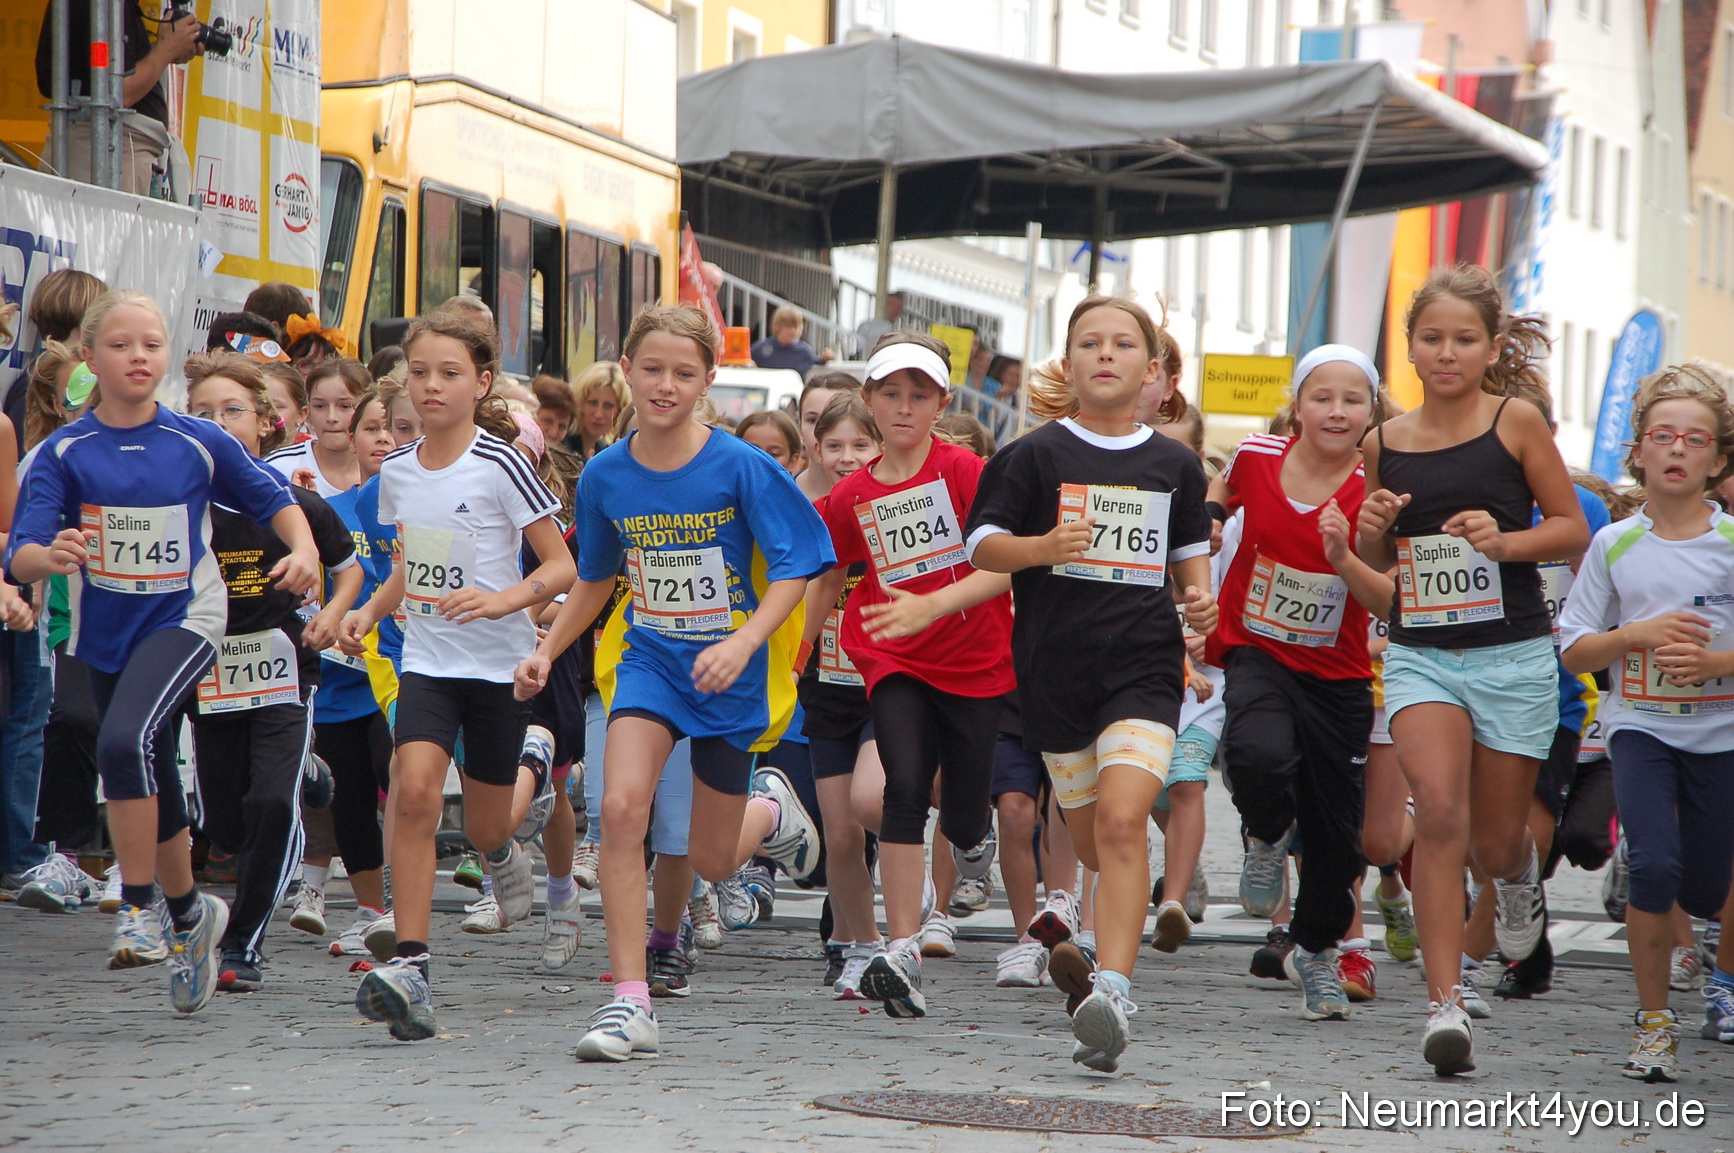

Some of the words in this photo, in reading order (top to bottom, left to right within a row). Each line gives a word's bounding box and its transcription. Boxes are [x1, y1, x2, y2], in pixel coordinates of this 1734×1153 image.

[239, 194, 258, 214] BÖGL
[1233, 389, 1258, 400] lauf
[876, 496, 935, 522] Christina
[1093, 493, 1143, 516] Verena
[108, 513, 151, 531] Selina
[624, 507, 735, 533] NEUMARKTER
[626, 528, 717, 547] STADTLAUF
[886, 514, 950, 553] 7034
[1092, 524, 1160, 554] 7165
[110, 540, 180, 565] 7145
[218, 550, 264, 558] NEUMARKTER
[221, 556, 260, 564] STADTLAUF
[643, 551, 703, 568] Fabienne
[927, 548, 966, 567] PFLEIDERER
[1414, 542, 1461, 564] Sophie
[407, 560, 464, 590] 7293
[1125, 569, 1163, 580] PFLEIDERER
[1420, 566, 1491, 597] 7006
[648, 576, 717, 602] 7213
[1276, 572, 1305, 591] Ann-
[1307, 582, 1346, 601] Kathrin
[686, 613, 730, 625] PFLEIDERER
[1274, 593, 1337, 624] 7207
[1459, 605, 1501, 617] PFLEIDERER
[222, 641, 262, 657] Melina
[225, 658, 289, 685] 7102
[261, 691, 297, 700] PFLEIDERER
